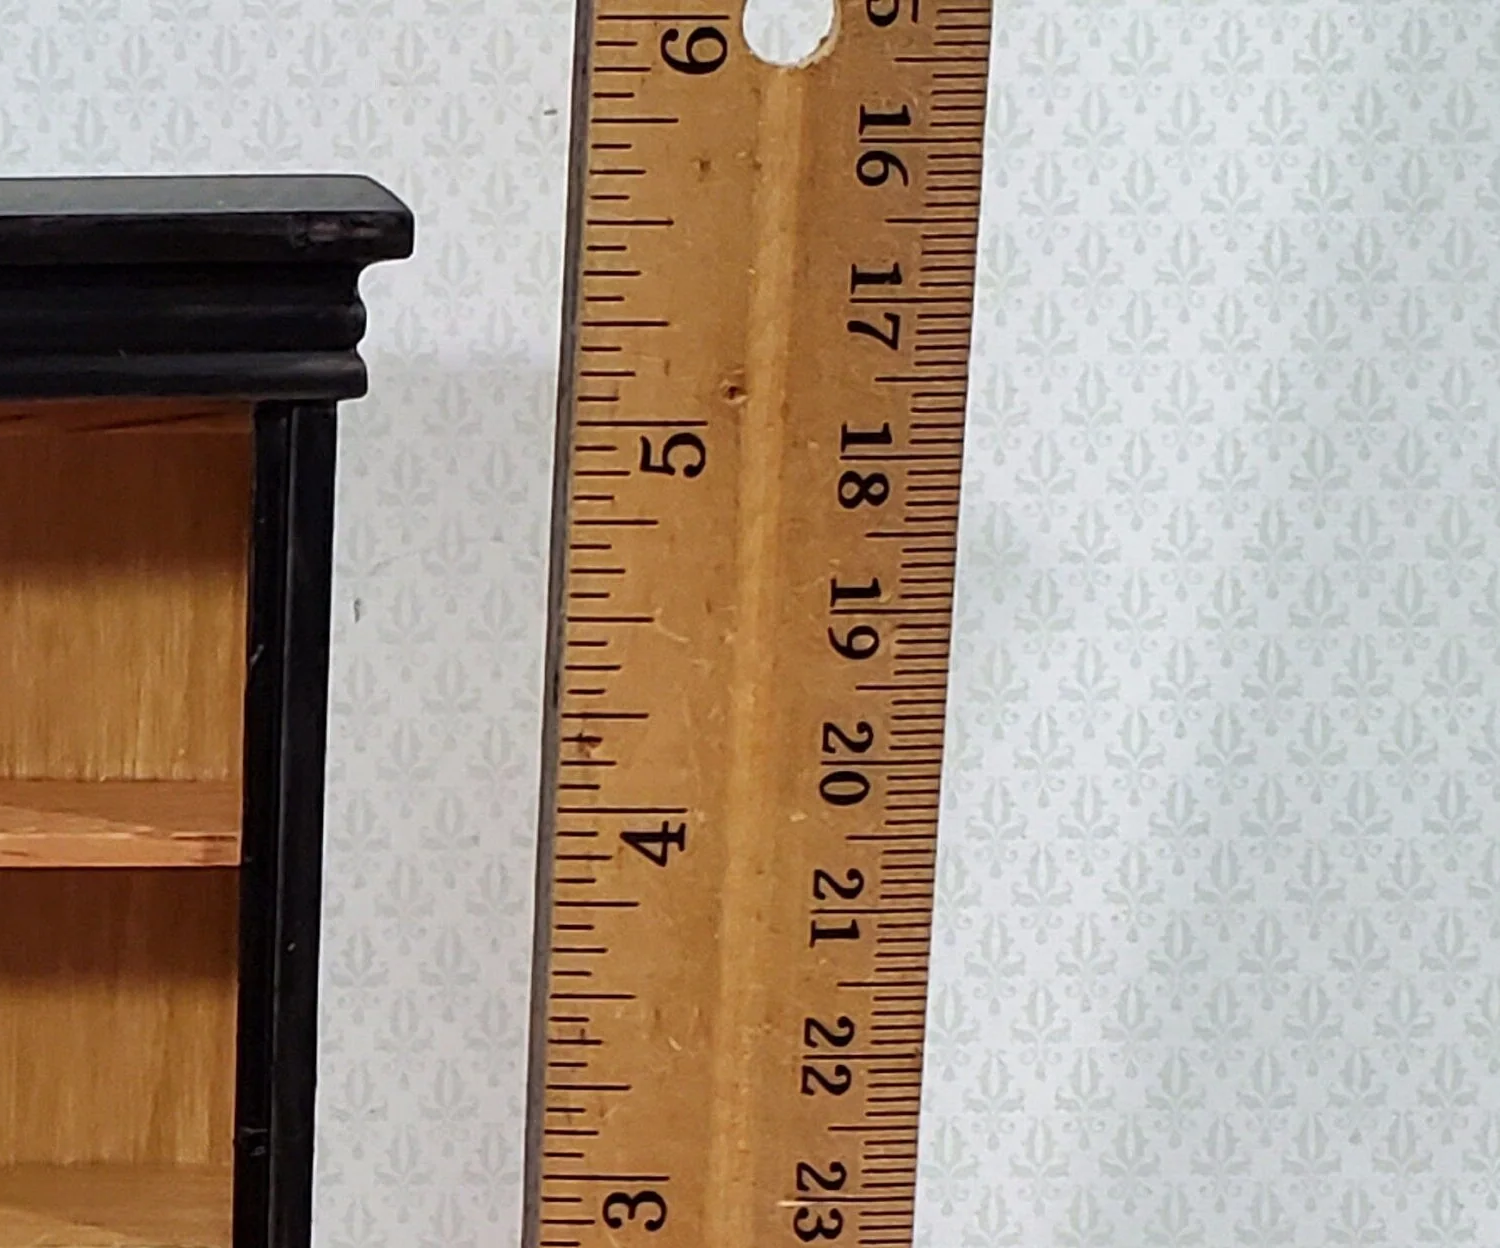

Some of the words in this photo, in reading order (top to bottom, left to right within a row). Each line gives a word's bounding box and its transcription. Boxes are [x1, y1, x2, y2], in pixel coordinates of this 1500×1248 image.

[660, 26, 729, 75] 6
[856, 104, 912, 188] 16
[847, 263, 903, 351] 17
[640, 433, 707, 478] 5
[838, 422, 893, 509] 18
[828, 577, 881, 661] 19
[819, 721, 874, 806] 20
[619, 820, 687, 867] 4
[809, 868, 865, 948] 21
[801, 1016, 856, 1096] 22
[602, 1190, 668, 1231] 3
[793, 1161, 847, 1242] 23
